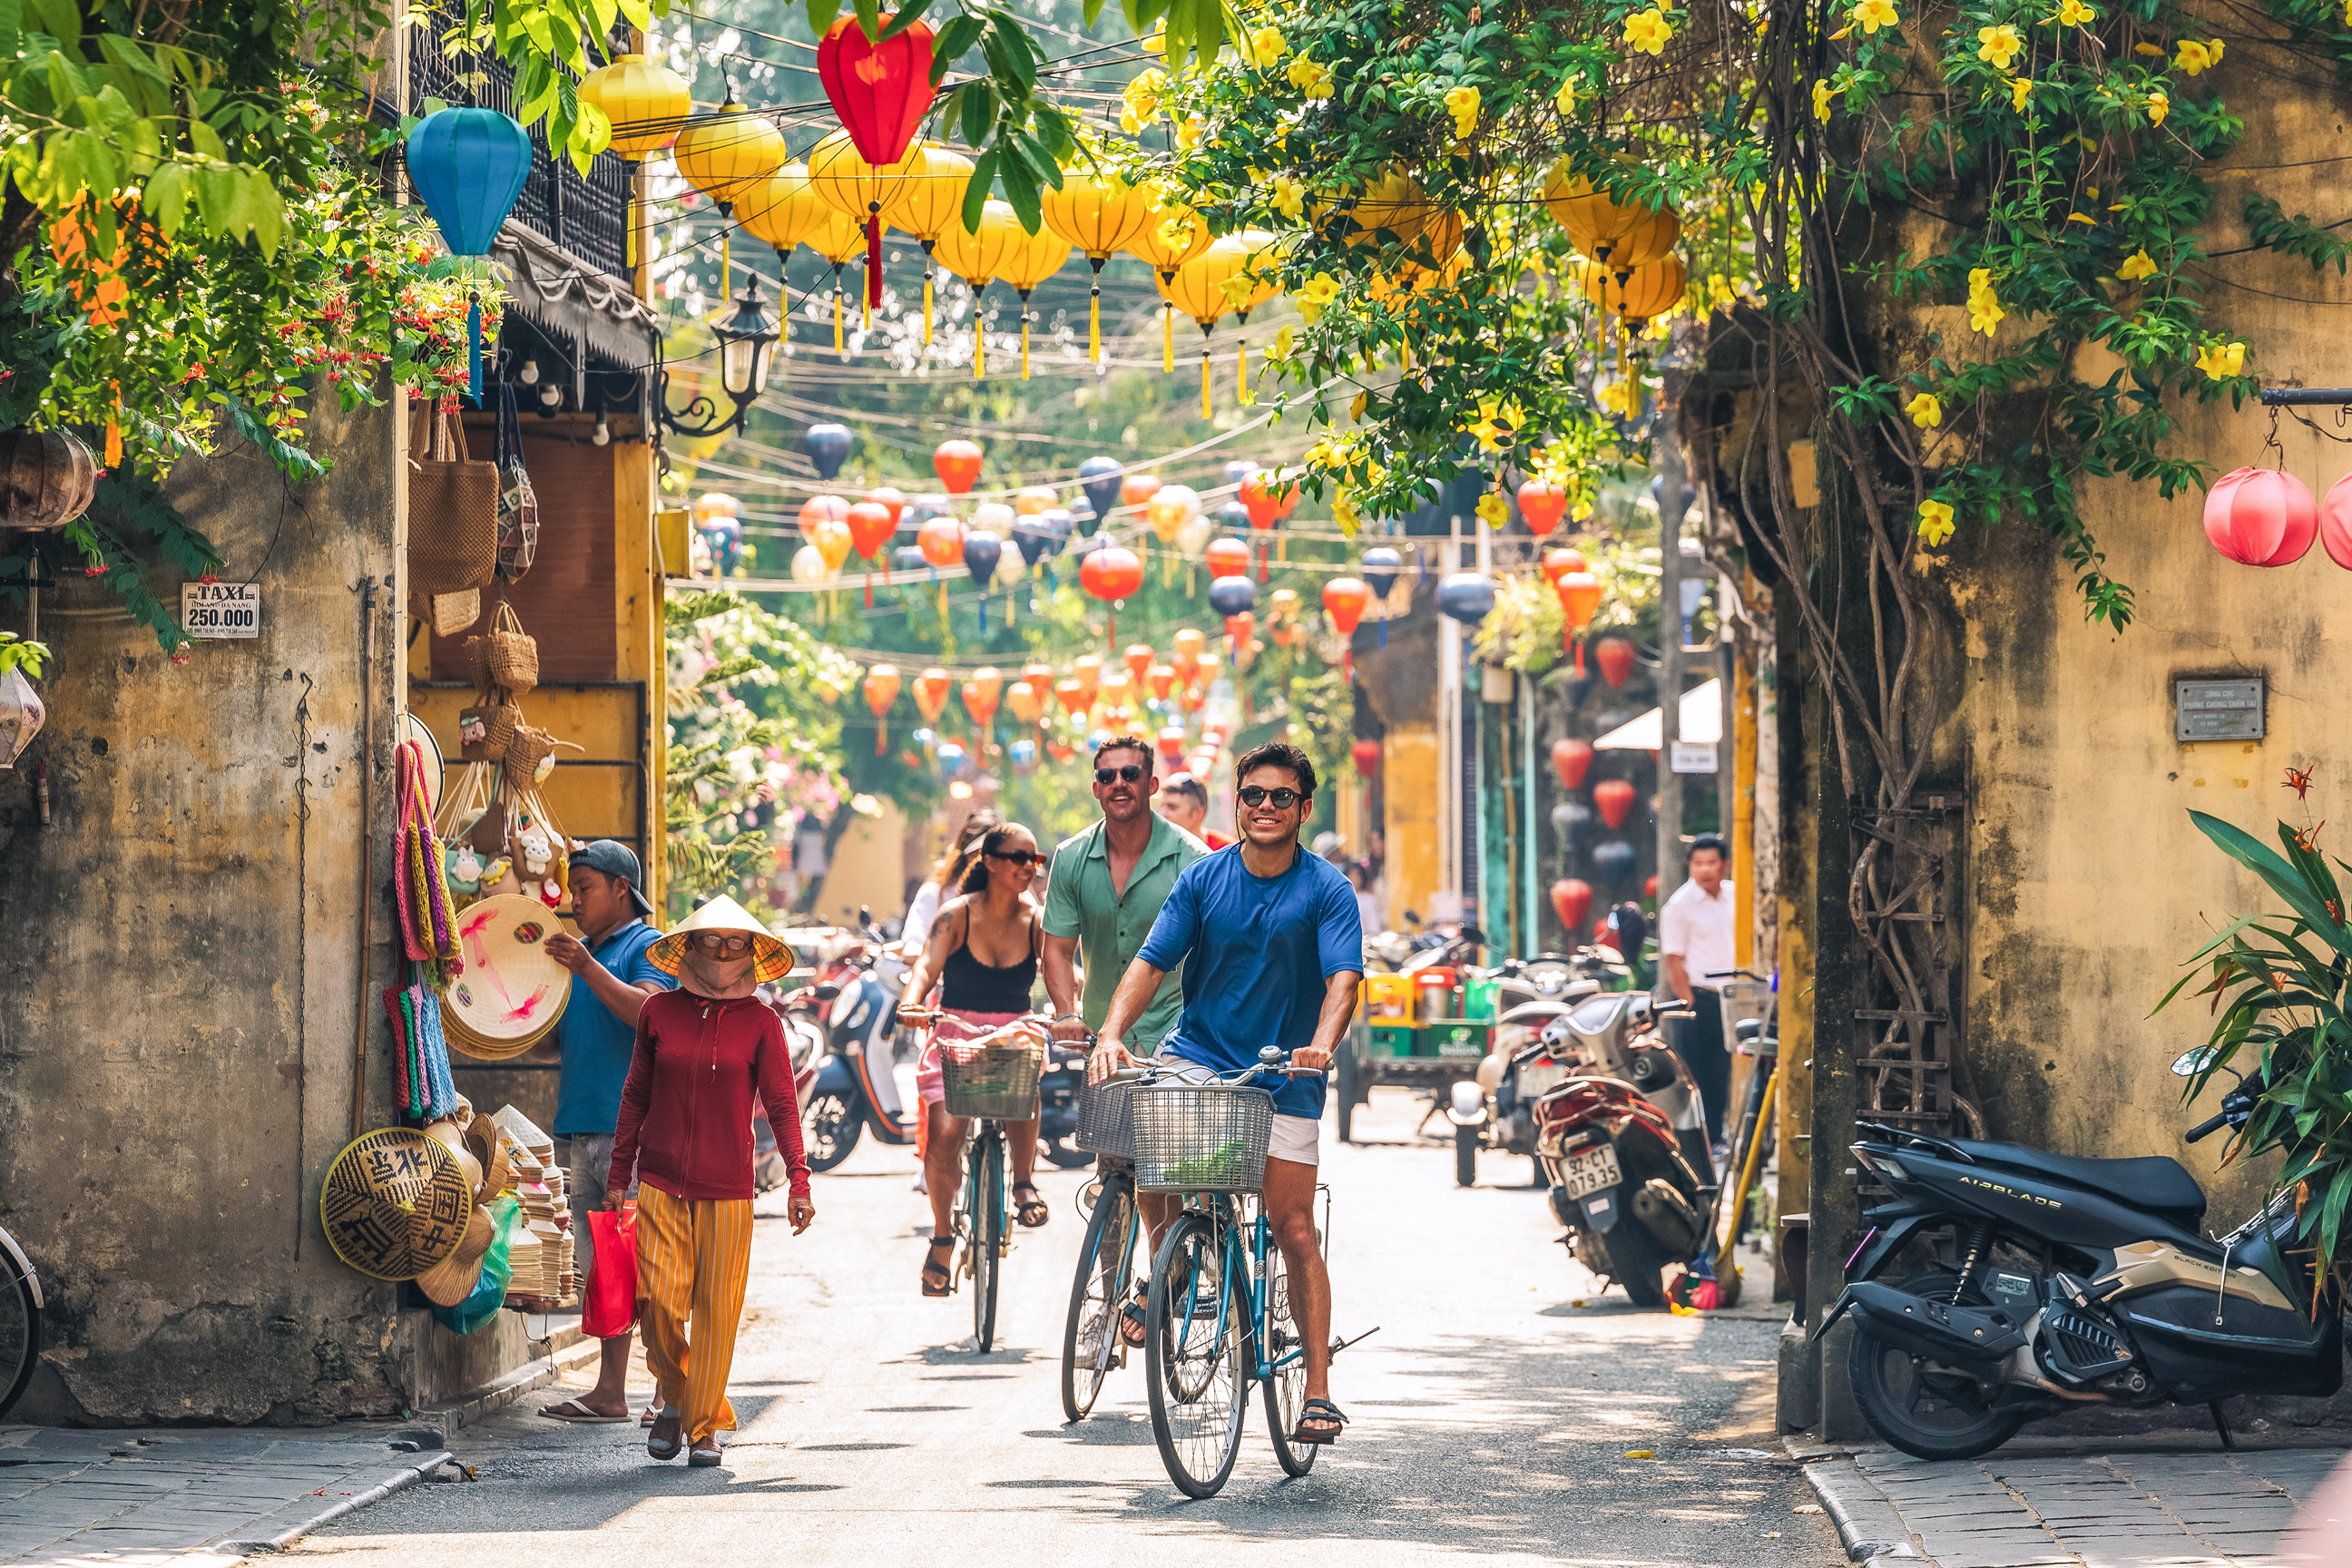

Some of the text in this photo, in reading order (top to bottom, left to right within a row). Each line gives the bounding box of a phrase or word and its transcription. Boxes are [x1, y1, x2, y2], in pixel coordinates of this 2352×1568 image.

[198, 586, 245, 600] TAXI
[189, 609, 253, 626] 250.000
[1569, 1165, 1619, 1196] 079.35
[2173, 1255, 2237, 1279] BLACK EDITON
